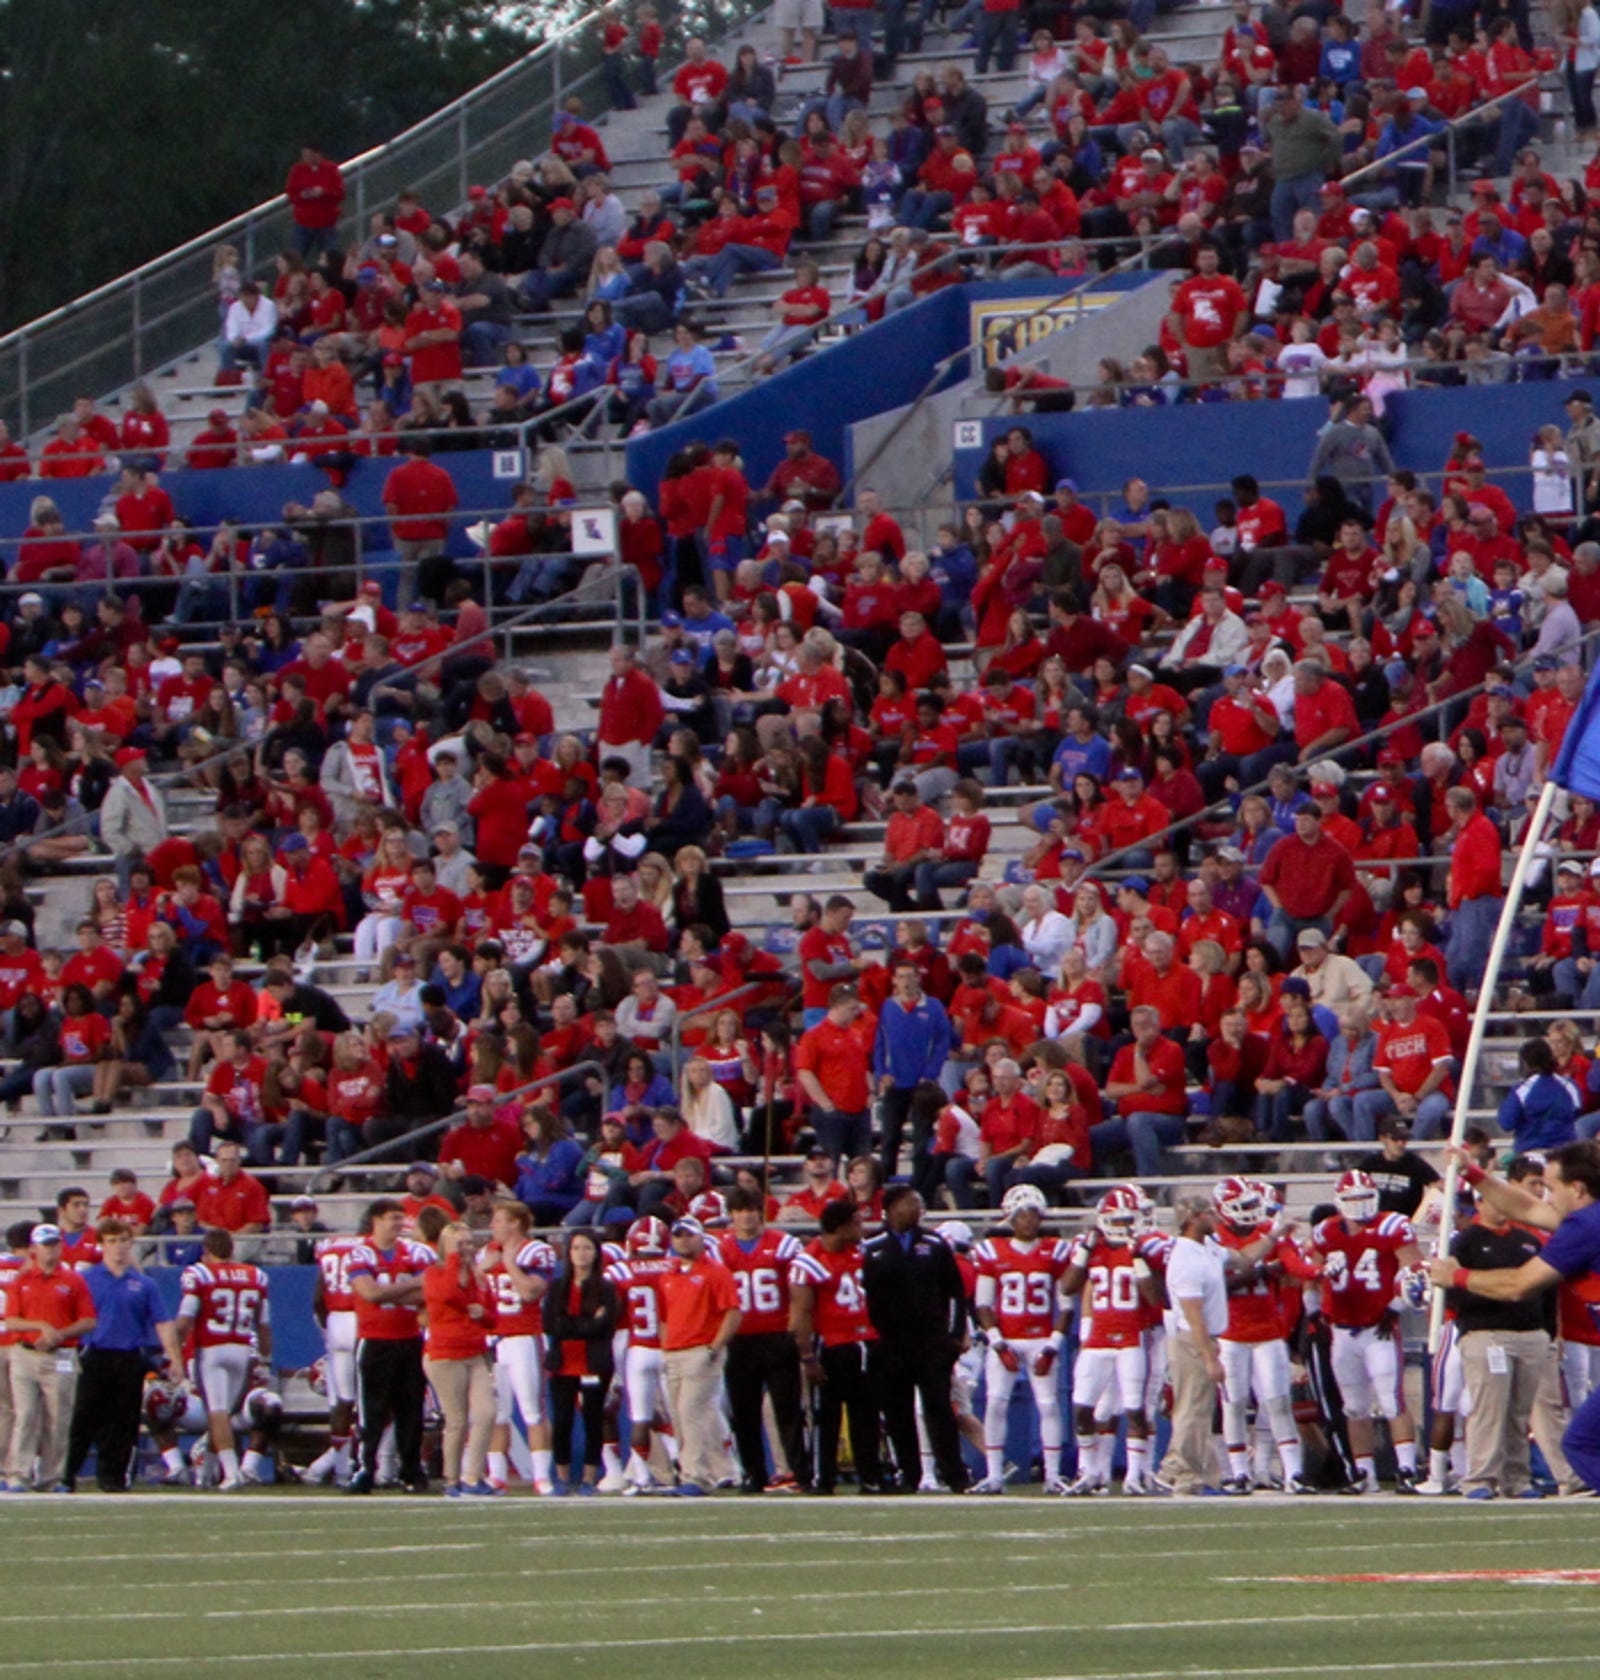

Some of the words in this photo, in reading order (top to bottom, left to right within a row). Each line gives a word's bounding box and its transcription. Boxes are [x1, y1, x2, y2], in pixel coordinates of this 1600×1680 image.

[1385, 1032, 1427, 1059] TECH
[1001, 1271, 1051, 1315] 83
[1090, 1265, 1139, 1310] 20
